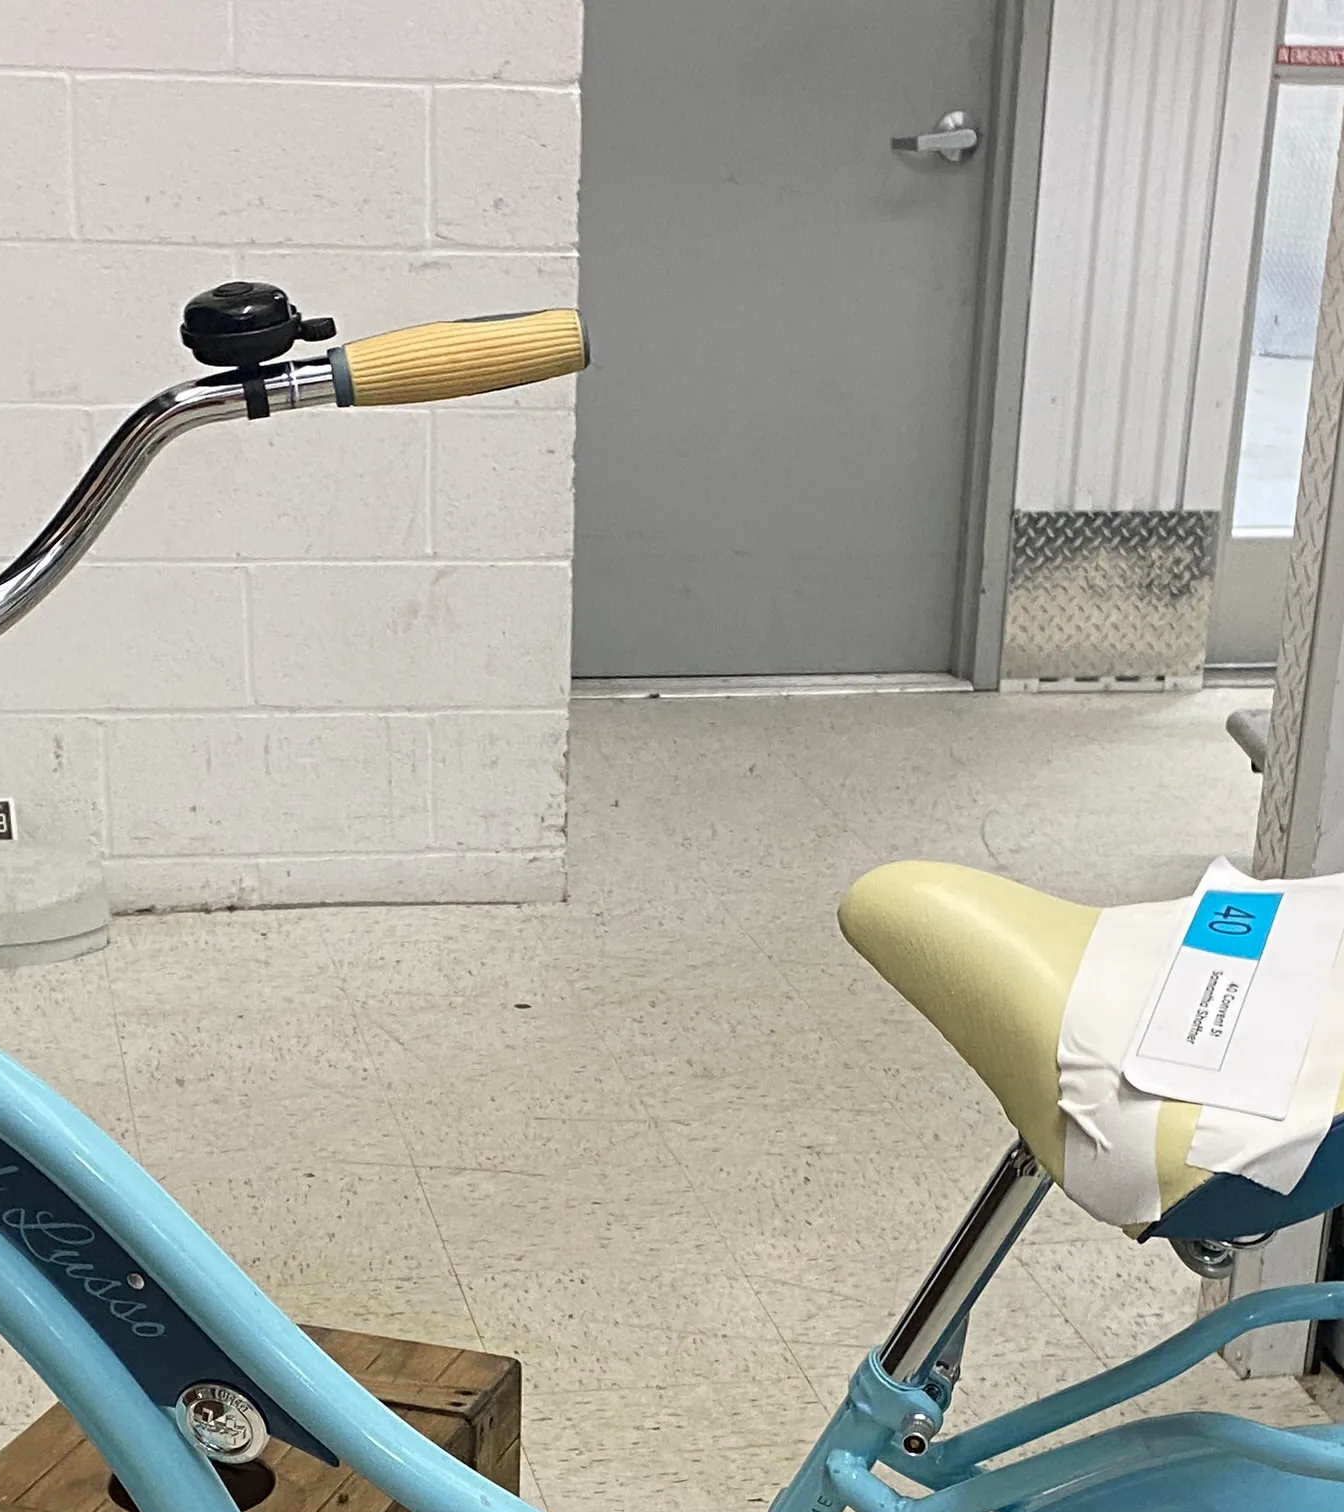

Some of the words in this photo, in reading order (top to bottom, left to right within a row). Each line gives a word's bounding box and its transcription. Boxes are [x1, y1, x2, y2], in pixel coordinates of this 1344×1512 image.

[1208, 904, 1258, 937] 40
[1225, 983, 1239, 993] 40
[1213, 994, 1235, 1027] Convent
[1209, 1027, 1223, 1037] St
[2, 1207, 166, 1339] Lusso
